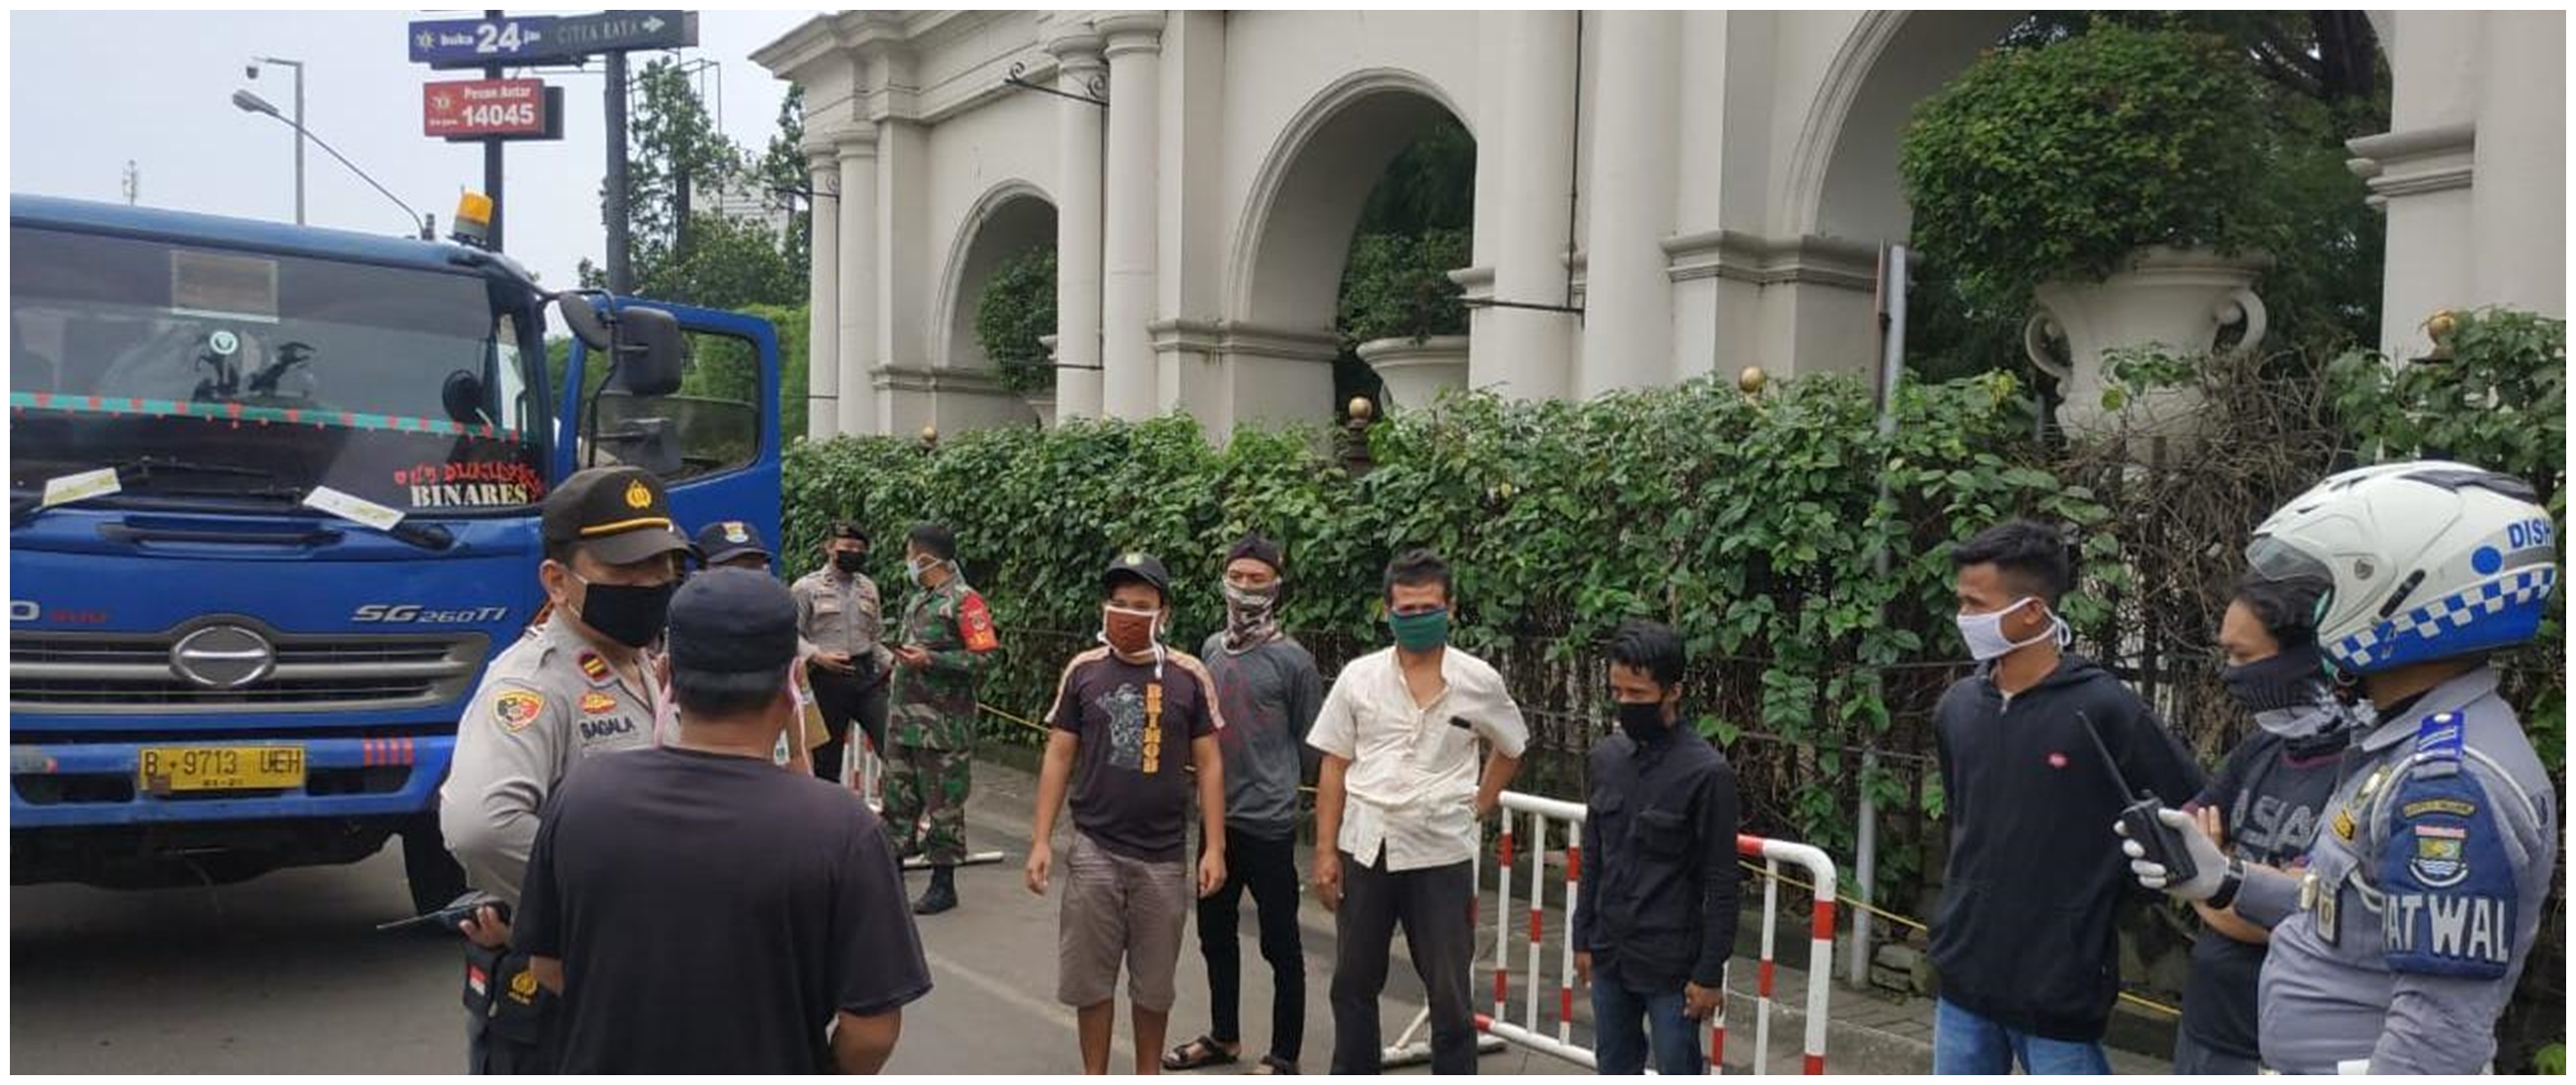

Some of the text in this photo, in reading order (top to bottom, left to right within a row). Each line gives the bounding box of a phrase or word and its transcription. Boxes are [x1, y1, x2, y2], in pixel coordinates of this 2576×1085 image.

[476, 22, 521, 53] 24
[463, 103, 536, 127] 14045
[410, 483, 528, 507] BINARES
[145, 750, 301, 775] B 9713 UEH
